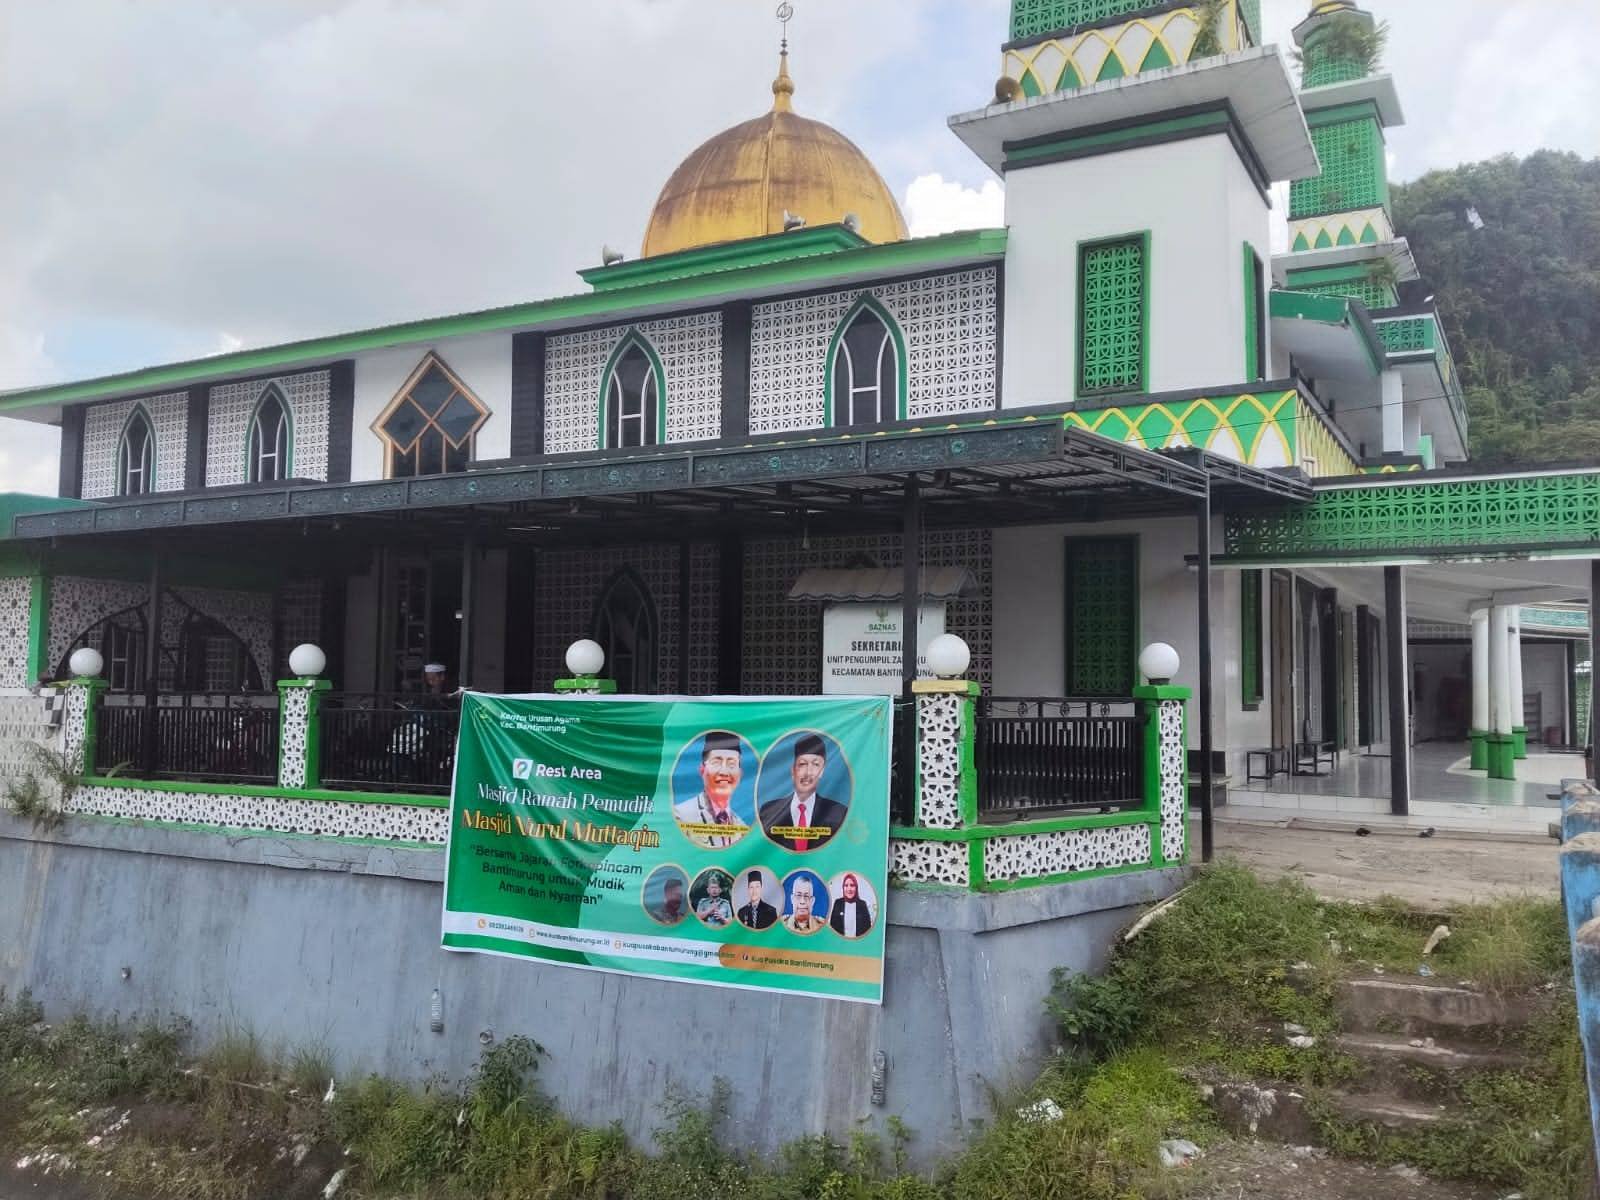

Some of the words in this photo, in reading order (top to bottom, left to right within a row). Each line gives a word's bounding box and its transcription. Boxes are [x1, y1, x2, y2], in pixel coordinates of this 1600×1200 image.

[868, 623, 897, 632] BAZNAS
[851, 640, 904, 652] SEKRETARI
[827, 655, 843, 664] UNIT
[845, 655, 890, 665] PENGUMPUL
[831, 667, 876, 677] KECAMATAN
[500, 720, 516, 729] Kec.
[528, 714, 553, 723] Urusan
[535, 763, 567, 779] Rest
[570, 765, 602, 781] Area
[478, 782, 518, 805] Masjid
[519, 787, 577, 809] Ramah
[581, 792, 655, 814] Pemudik
[462, 808, 513, 836] Masjid
[514, 815, 568, 841] Nurul
[571, 820, 661, 852] Muttaqin
[482, 861, 546, 885] Bantimurung
[586, 877, 626, 891] Mudik
[498, 880, 527, 896] Aman
[527, 885, 546, 899] dan
